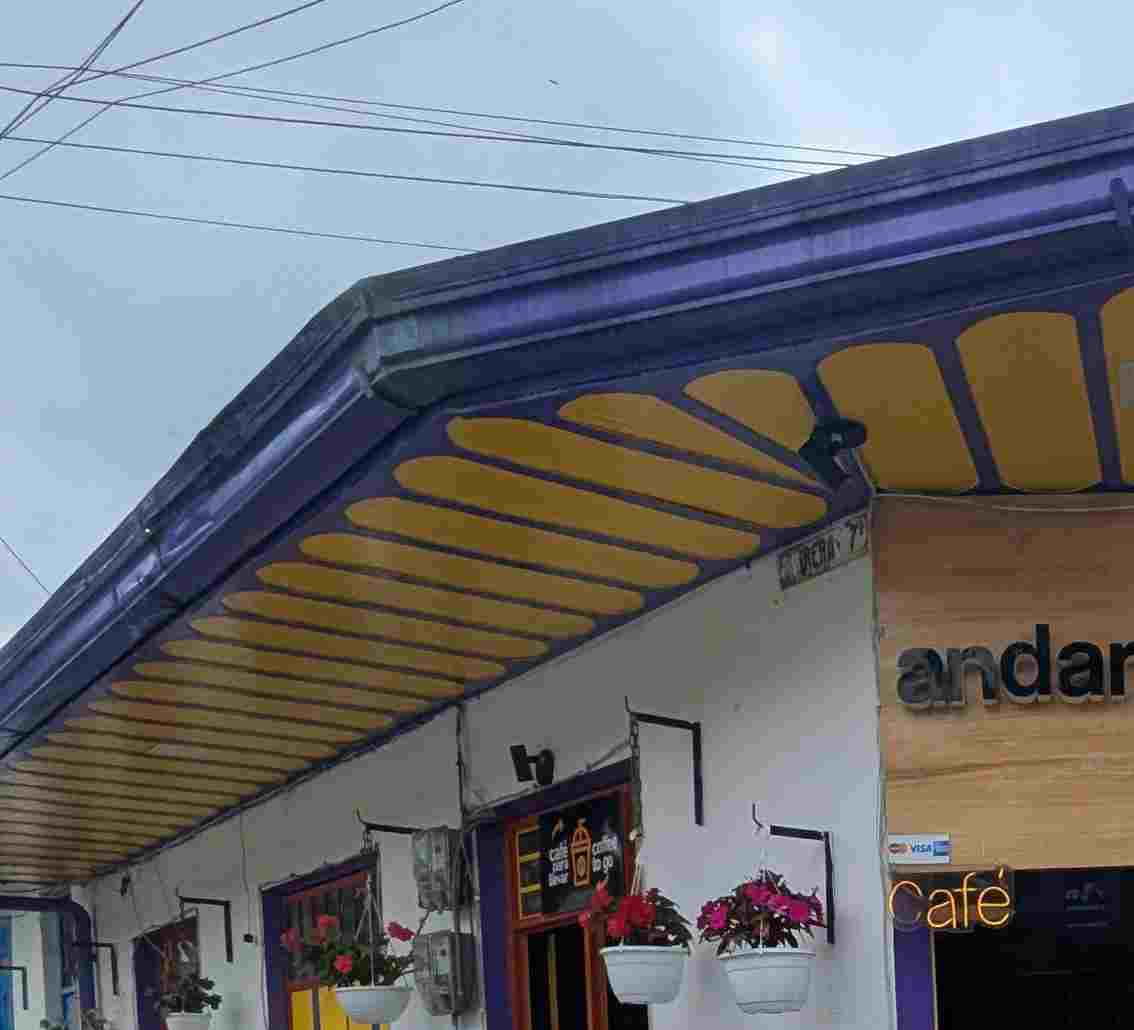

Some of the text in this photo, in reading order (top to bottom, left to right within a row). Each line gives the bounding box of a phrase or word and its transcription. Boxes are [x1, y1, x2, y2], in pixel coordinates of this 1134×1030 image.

[912, 843, 932, 853] VISA
[602, 855, 614, 874] go
[889, 867, 1011, 929] Café
